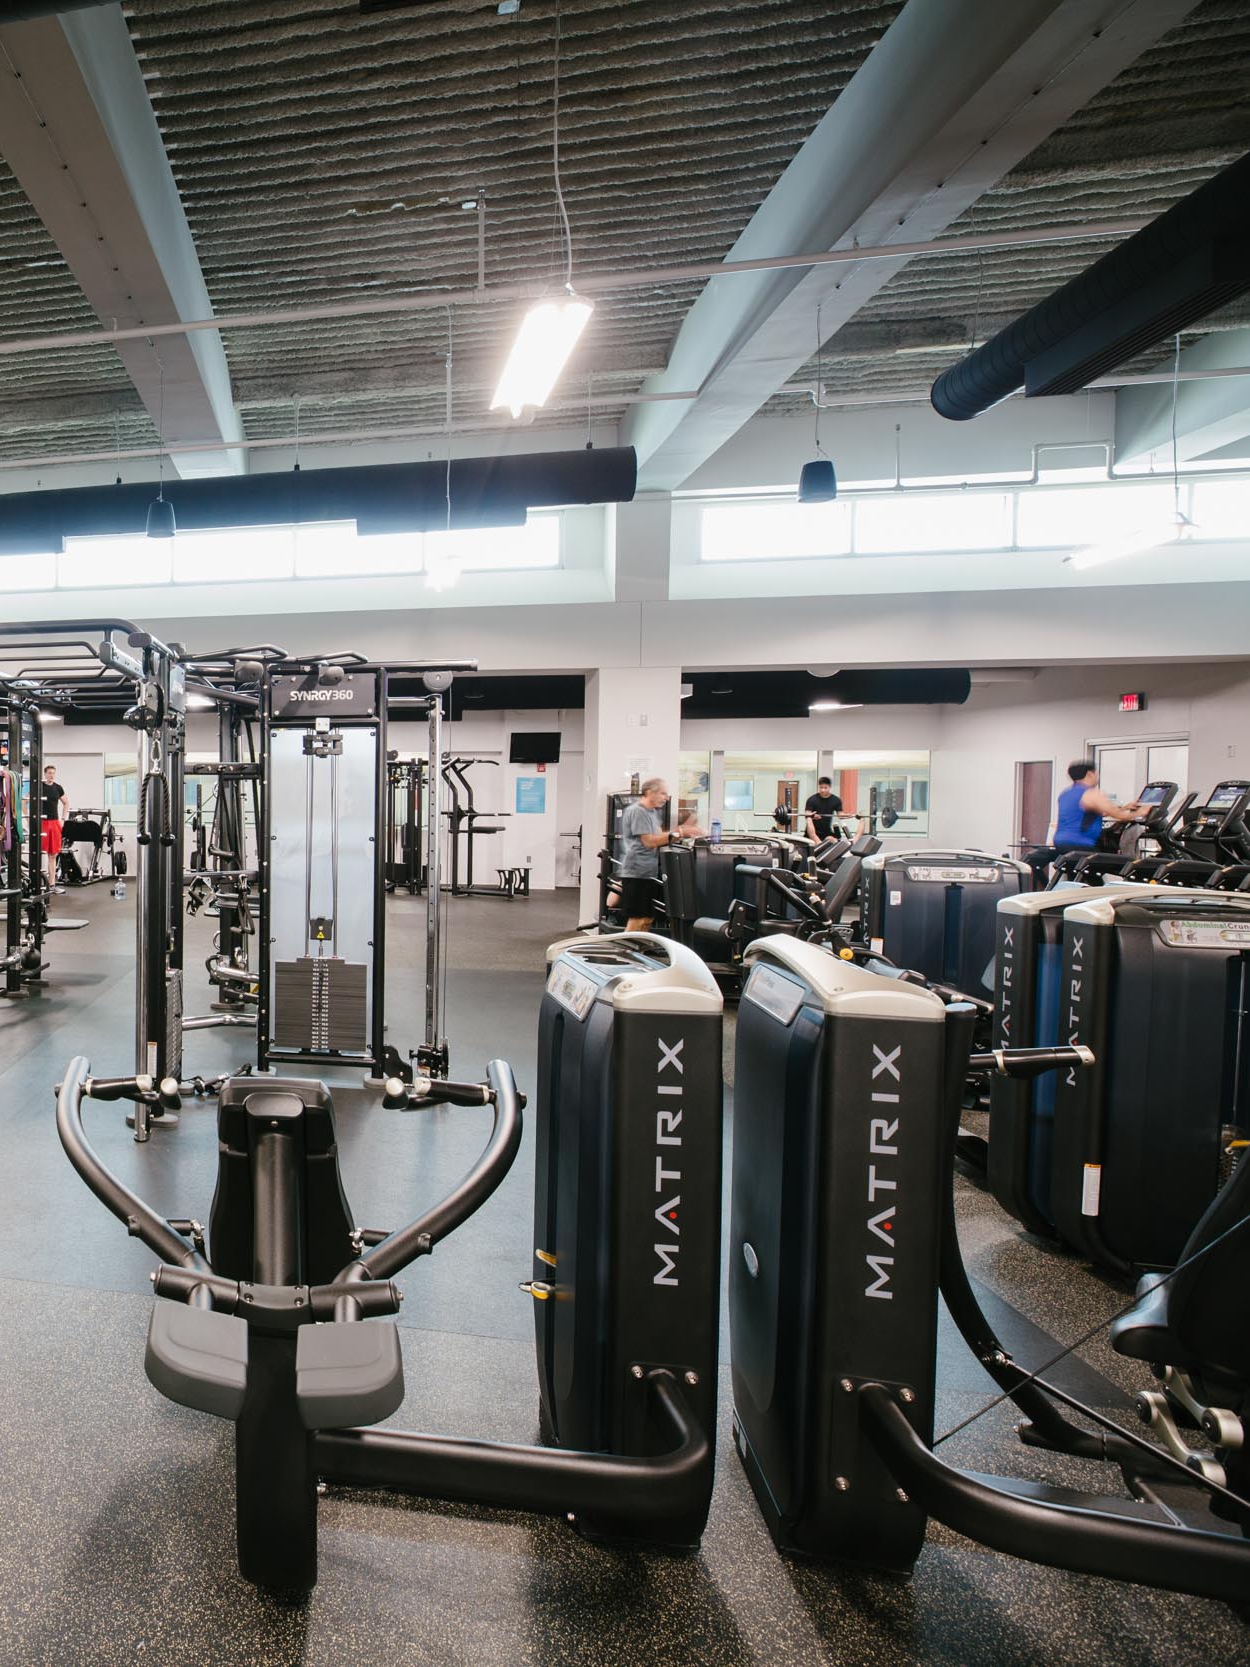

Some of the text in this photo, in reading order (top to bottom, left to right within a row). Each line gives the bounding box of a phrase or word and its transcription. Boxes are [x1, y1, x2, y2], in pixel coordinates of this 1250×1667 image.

[290, 690, 353, 701] SYNRGY360
[653, 1037, 684, 1286] MATRIX
[865, 1043, 901, 1300] MATRIX
